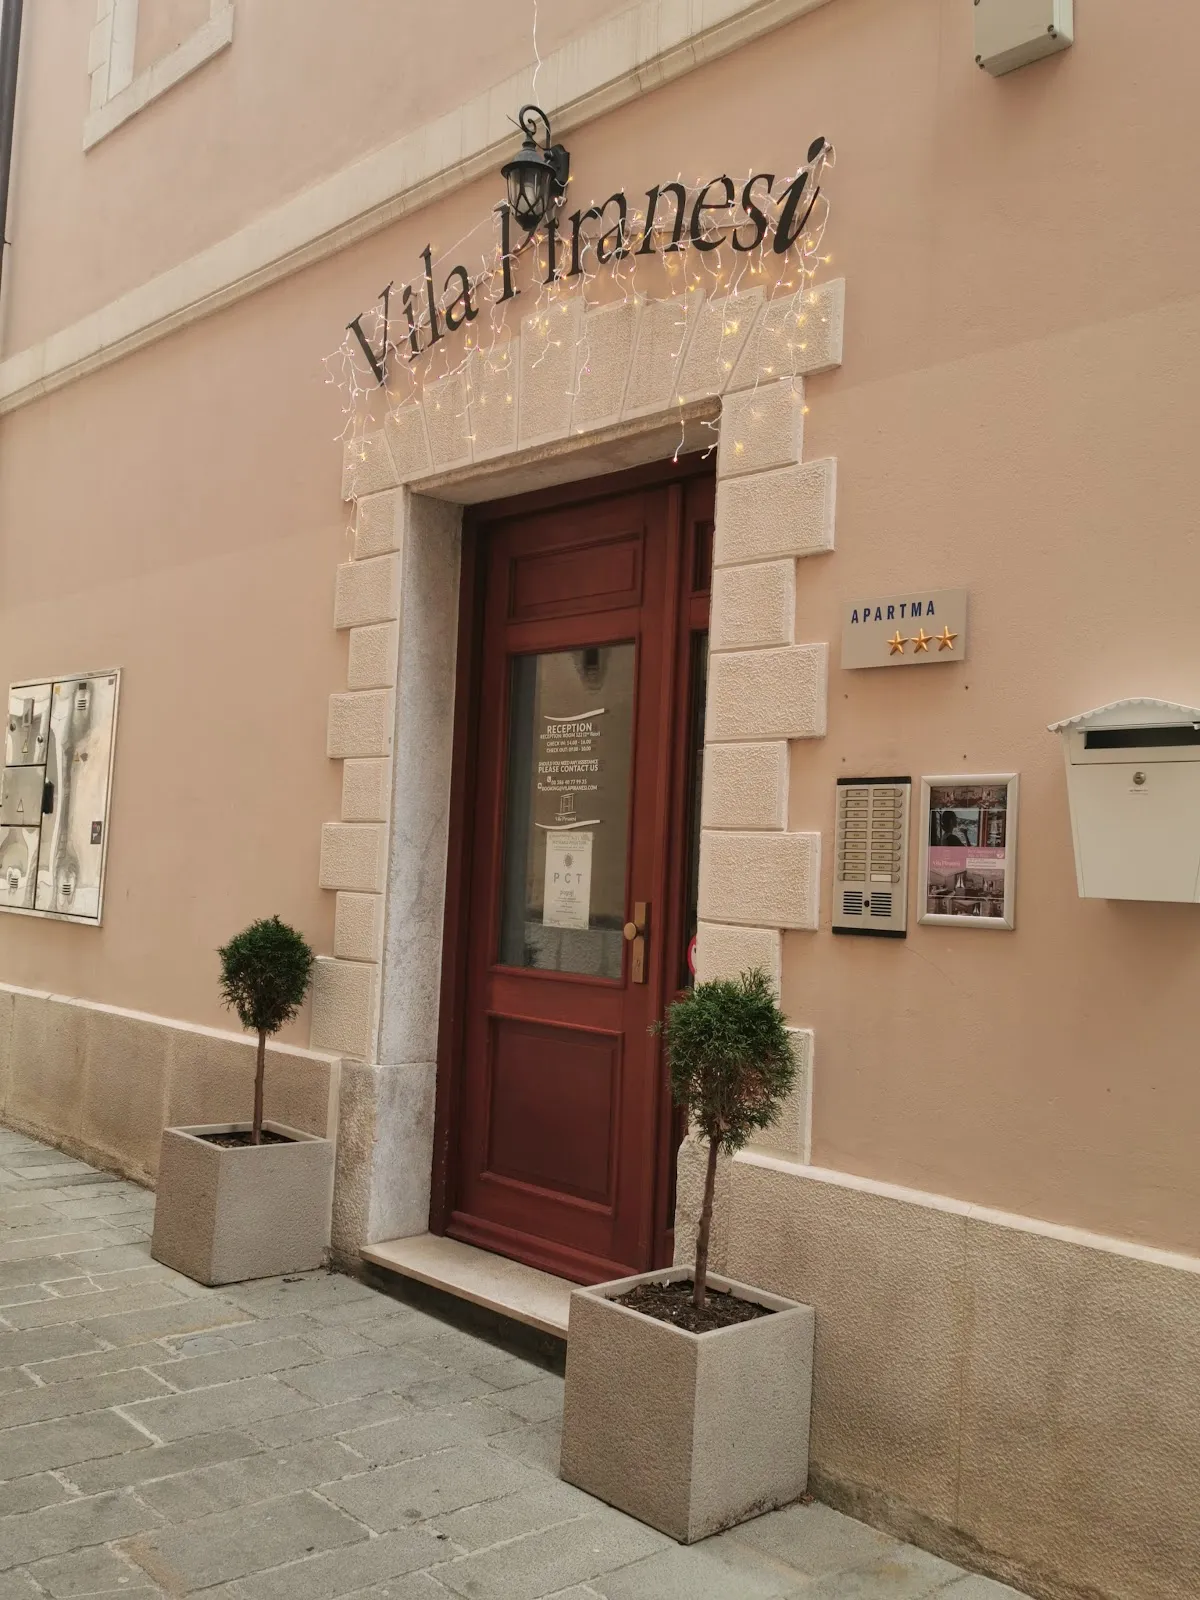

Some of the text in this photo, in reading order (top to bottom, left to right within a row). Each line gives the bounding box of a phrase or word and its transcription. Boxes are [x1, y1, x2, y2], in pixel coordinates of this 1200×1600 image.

[345, 136, 828, 387] Vila Piranesi
[851, 600, 935, 624] APARTMA
[547, 723, 592, 734] RECEPTION
[538, 766, 560, 774] PLEASE
[560, 765, 589, 773] CONTACT
